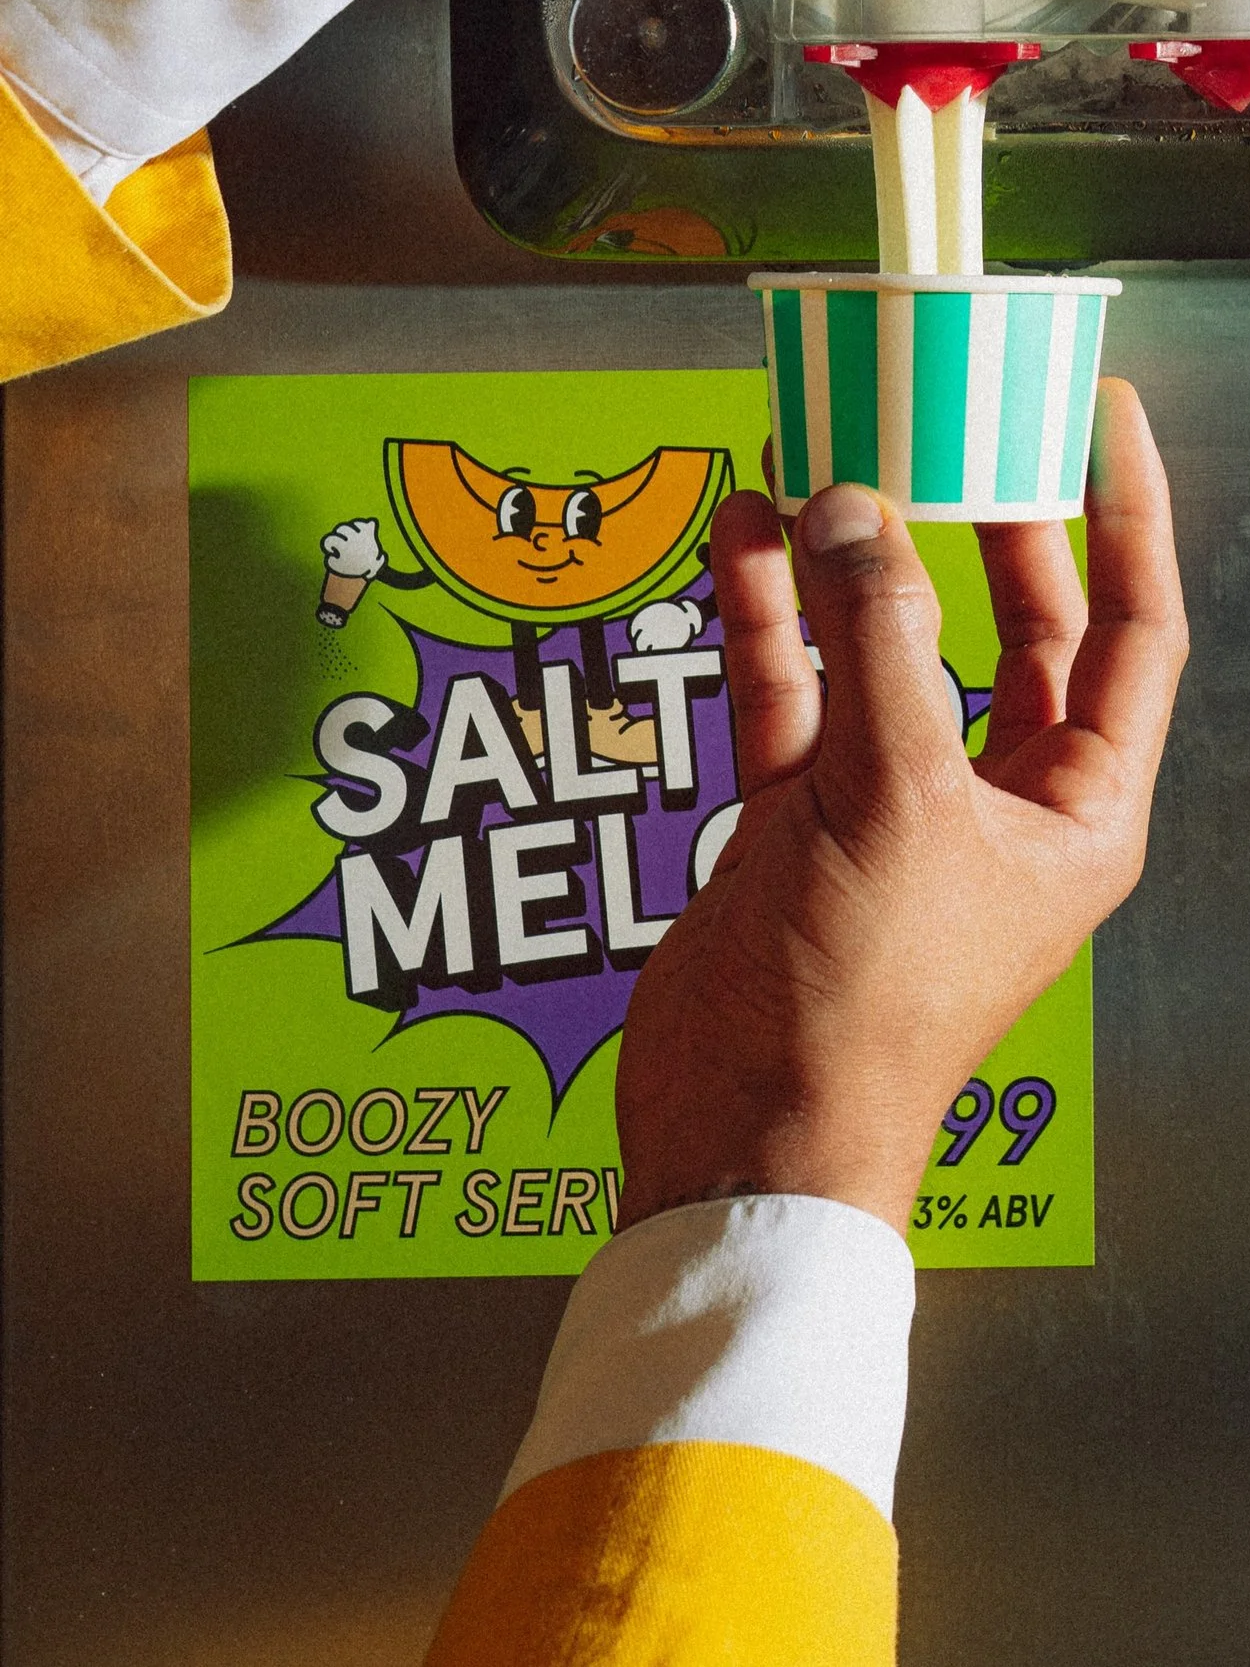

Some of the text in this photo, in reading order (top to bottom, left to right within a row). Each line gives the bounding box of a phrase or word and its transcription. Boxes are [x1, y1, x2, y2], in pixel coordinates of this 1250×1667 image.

[310, 644, 966, 842] SALT
[337, 798, 744, 1001] MEL
[230, 1086, 511, 1159] BOOZY
[229, 1169, 443, 1241] SOFT
[912, 1194, 1056, 1230] 3% ABV
